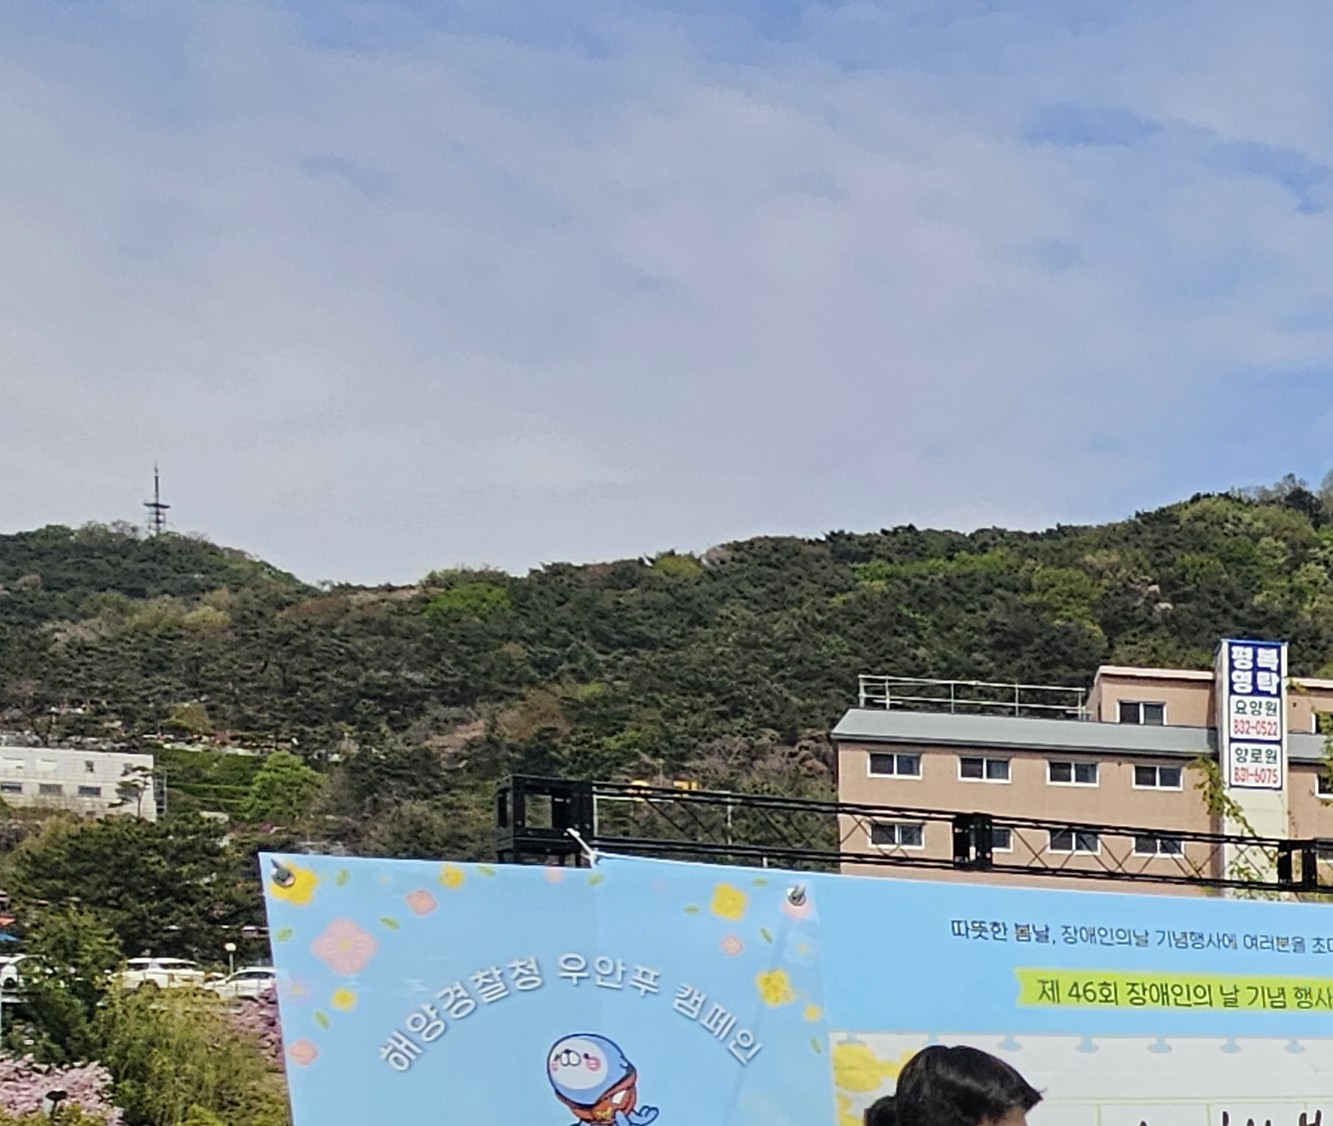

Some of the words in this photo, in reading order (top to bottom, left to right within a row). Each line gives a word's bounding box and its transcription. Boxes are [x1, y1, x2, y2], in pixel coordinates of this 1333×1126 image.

[1234, 700, 1278, 716] 요양원
[1235, 747, 1278, 764] 양로원
[950, 919, 1009, 942] 따뜻한
[1014, 922, 1057, 945] 봄날,
[1061, 925, 1150, 948] 장애인의날
[1156, 929, 1238, 951] 기념행사에
[1243, 932, 1306, 954] 여러분을
[1037, 979, 1061, 1004] 제
[1067, 980, 1119, 1006] 46회
[1126, 981, 1214, 1009] 장애인의
[1219, 983, 1241, 1009] 날
[1246, 984, 1288, 1010] 기념
[1293, 986, 1333, 1010] 행사
[378, 953, 544, 1075] 해양경찰청
[557, 951, 662, 999] 우안푸
[671, 980, 765, 1068] 캠페인
